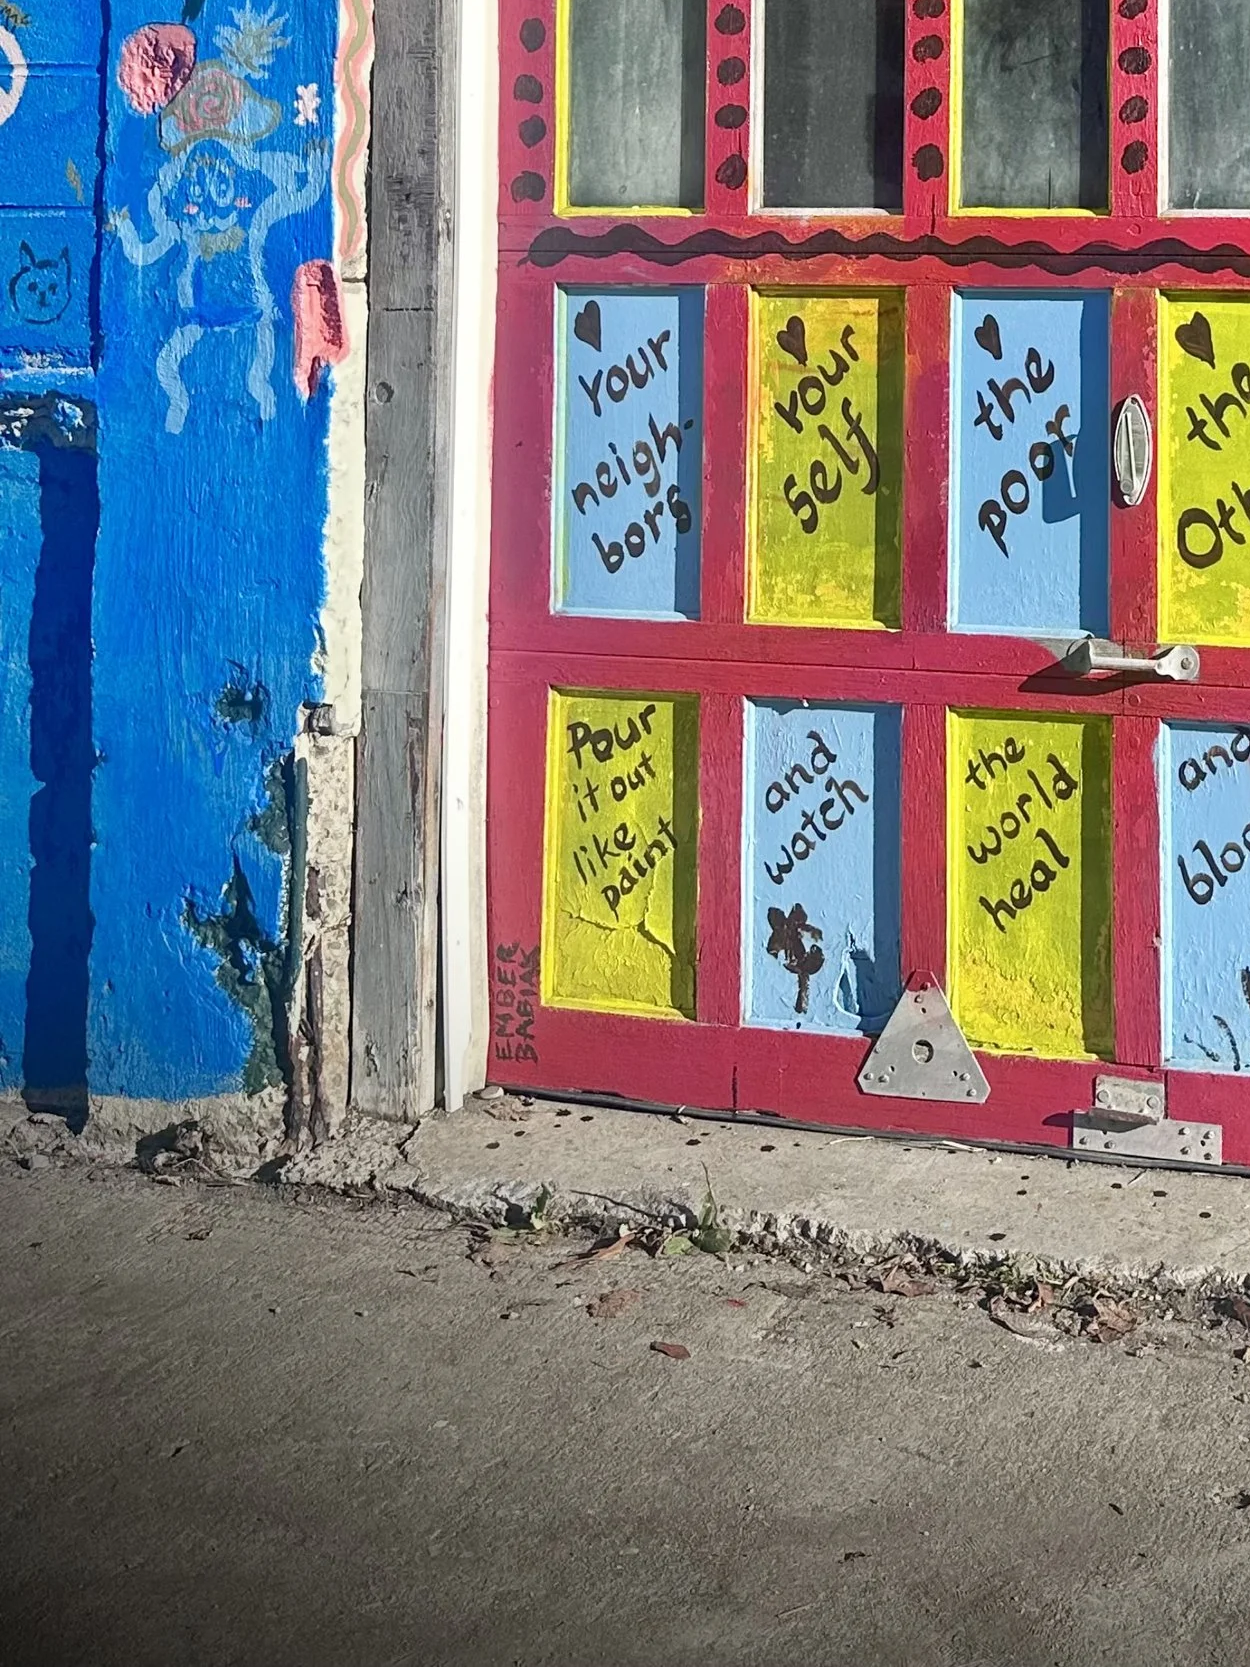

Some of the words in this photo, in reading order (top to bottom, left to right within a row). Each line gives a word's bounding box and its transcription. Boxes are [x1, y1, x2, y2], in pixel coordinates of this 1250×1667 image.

[974, 345, 1055, 441] the
[977, 403, 1074, 559] poor
[591, 484, 692, 574] bors
[566, 704, 657, 770] Pour
[764, 730, 839, 815] and
[964, 736, 1027, 792] the
[572, 780, 601, 823] it
[610, 752, 658, 804] out
[764, 775, 870, 885] watch
[967, 753, 1079, 865] world
[572, 821, 638, 887] like
[601, 816, 680, 922] paint
[979, 829, 1071, 934] heal
